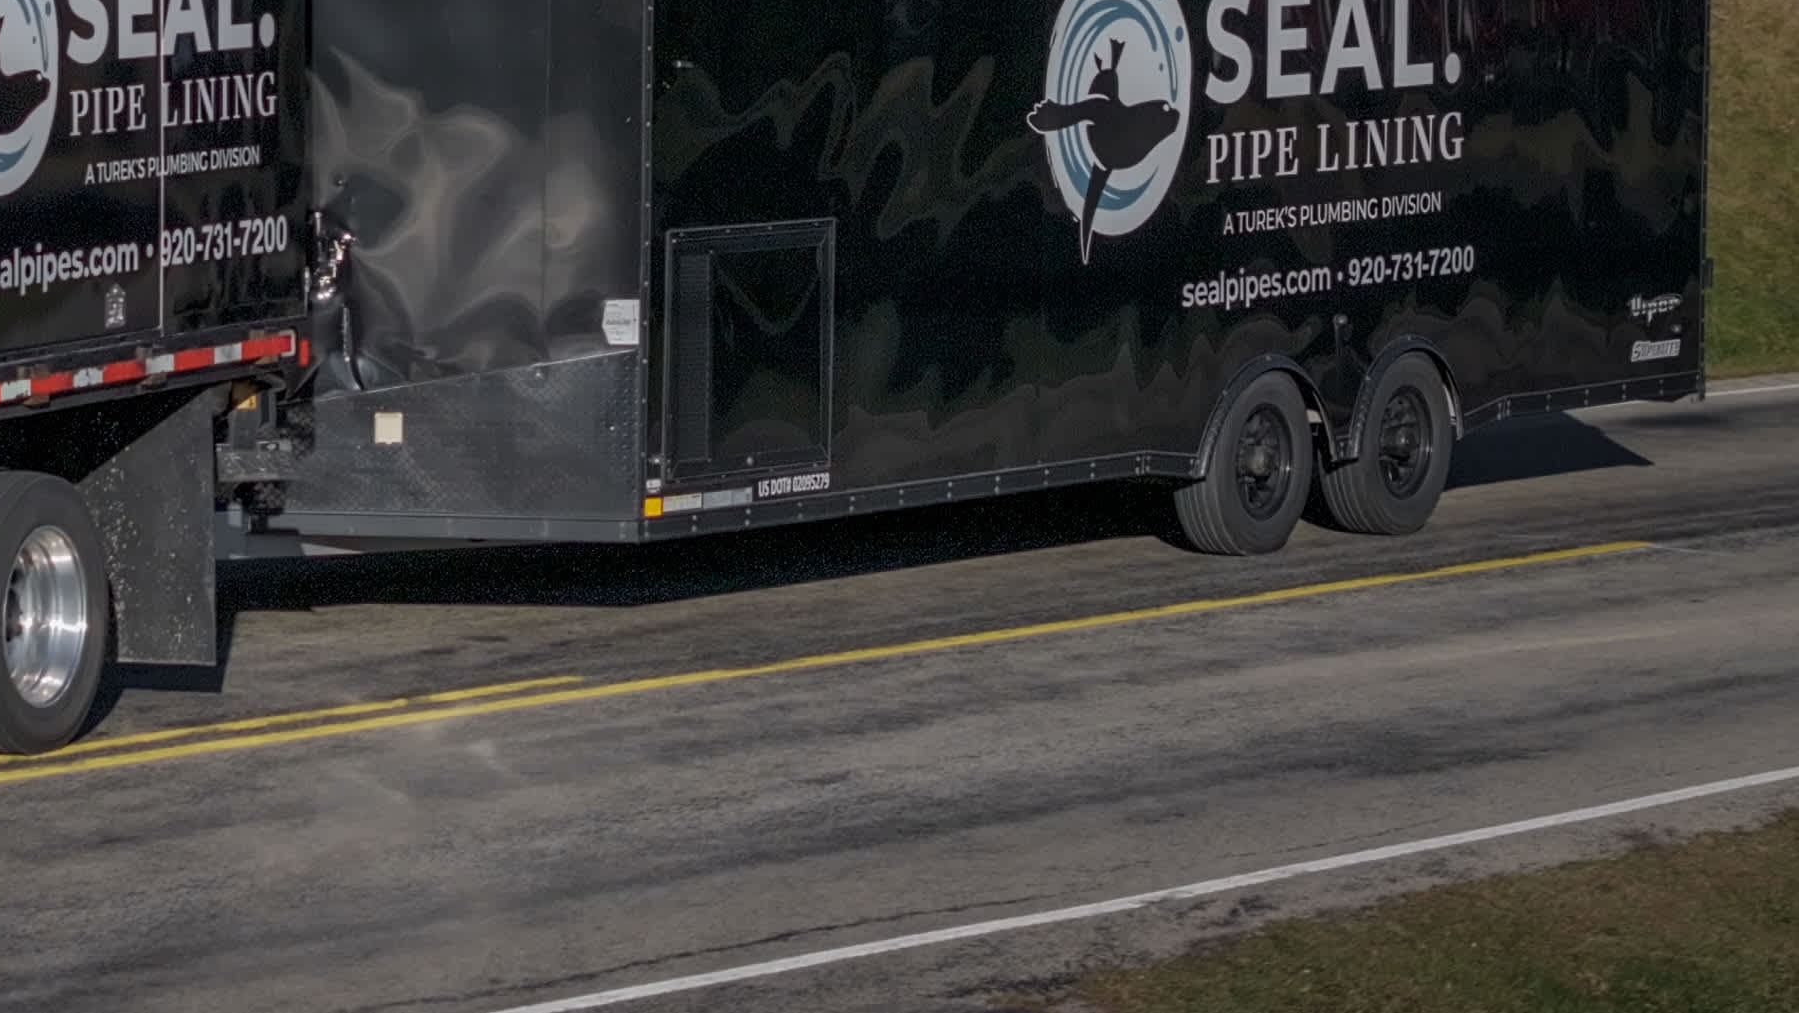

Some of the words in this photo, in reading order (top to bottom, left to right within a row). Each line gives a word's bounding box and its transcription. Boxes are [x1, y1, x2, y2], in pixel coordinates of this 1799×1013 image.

[69, 83, 147, 137] PIPE
[162, 71, 278, 129] LINING
[84, 167, 96, 186] A
[97, 157, 146, 184] TUREK'S
[147, 150, 209, 177] PLUMBING
[210, 145, 261, 170] DIVISION
[1206, 125, 1299, 184] PIPE
[1316, 111, 1465, 173] LINING
[1223, 213, 1235, 236] A
[1237, 205, 1297, 233] TUREK'S
[1300, 197, 1378, 227] PLUMBING
[1381, 191, 1442, 219] DIVISION
[160, 214, 288, 268] 920-731-7200
[1182, 266, 1331, 310] sealpipes.com
[1348, 244, 1475, 286] 920-731-7200
[758, 479, 770, 498] US
[770, 476, 792, 496] DOT#
